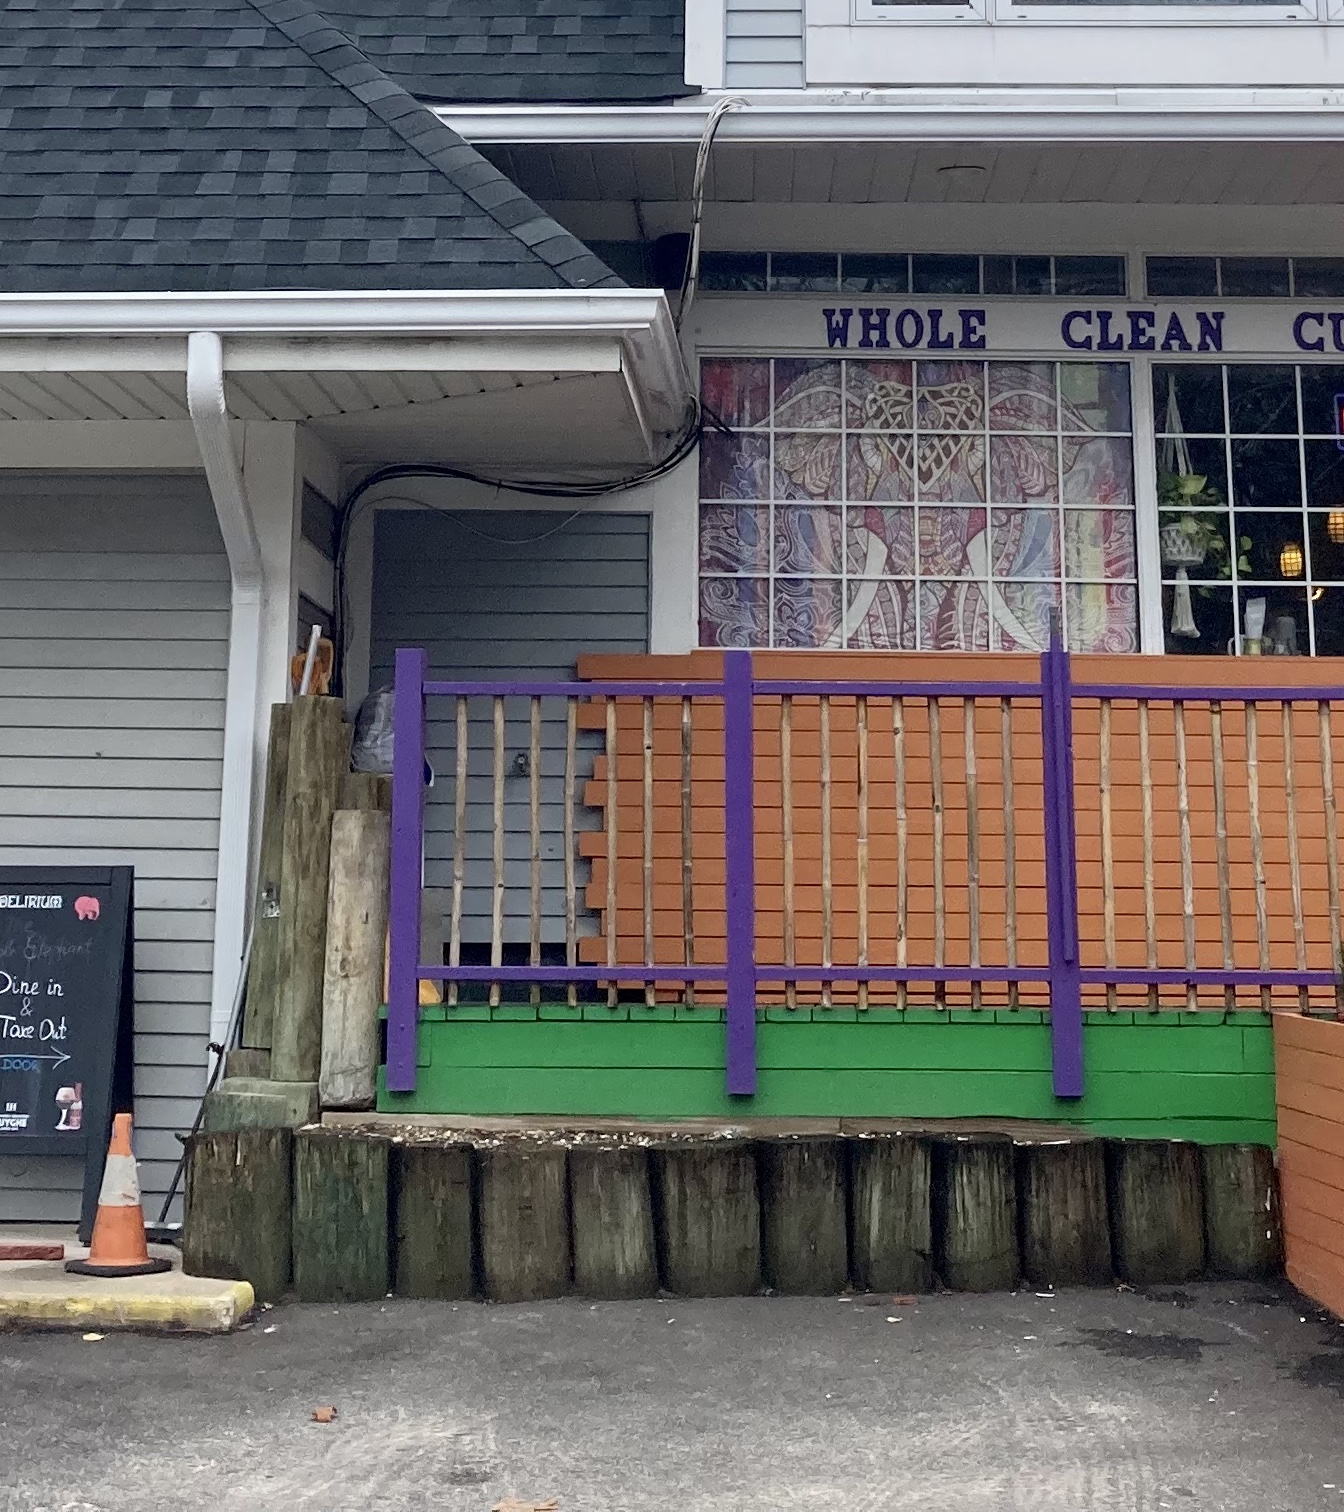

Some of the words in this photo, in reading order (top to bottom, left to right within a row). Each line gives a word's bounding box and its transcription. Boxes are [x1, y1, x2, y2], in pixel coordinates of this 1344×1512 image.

[822, 308, 986, 349] WHOLE
[1061, 310, 1225, 351] CLEAN
[46, 978, 65, 997] in
[19, 996, 34, 1018] &
[39, 1016, 68, 1041] Out
[0, 1059, 41, 1074] DOOR
